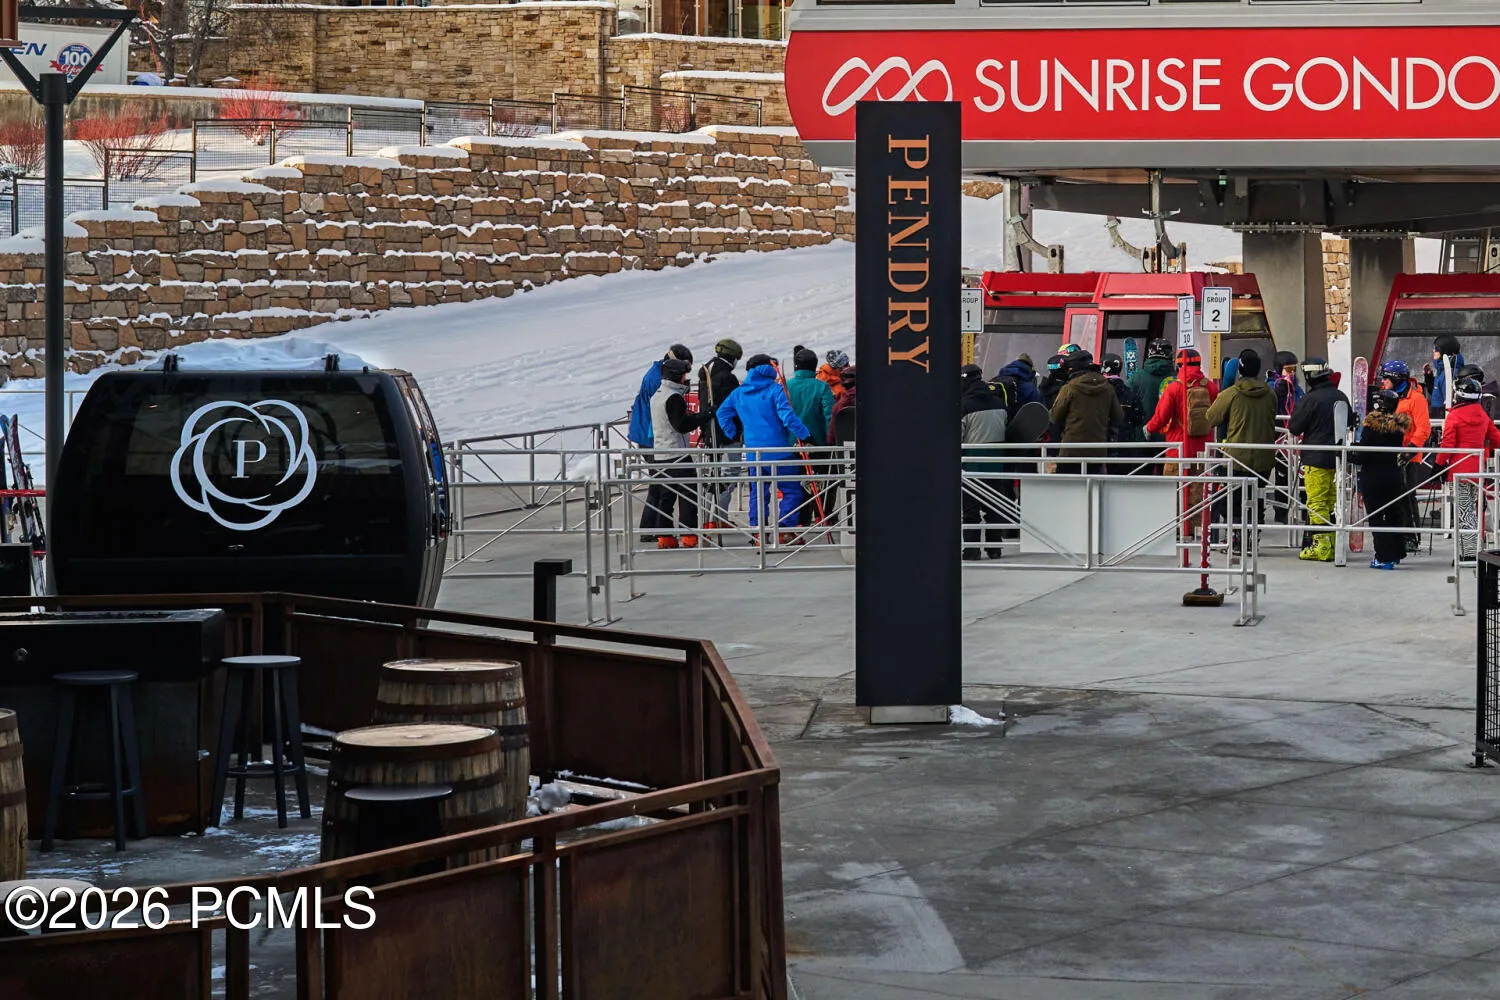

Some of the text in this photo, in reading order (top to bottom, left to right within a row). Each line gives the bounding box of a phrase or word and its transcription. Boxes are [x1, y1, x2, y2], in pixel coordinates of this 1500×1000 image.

[62, 51, 92, 66] 100
[973, 57, 1221, 112] SUNRISE
[888, 134, 930, 374] PENDRY
[966, 309, 971, 322] 1
[1211, 309, 1220, 322] 2
[1183, 333, 1191, 344] 10
[231, 439, 267, 479] P
